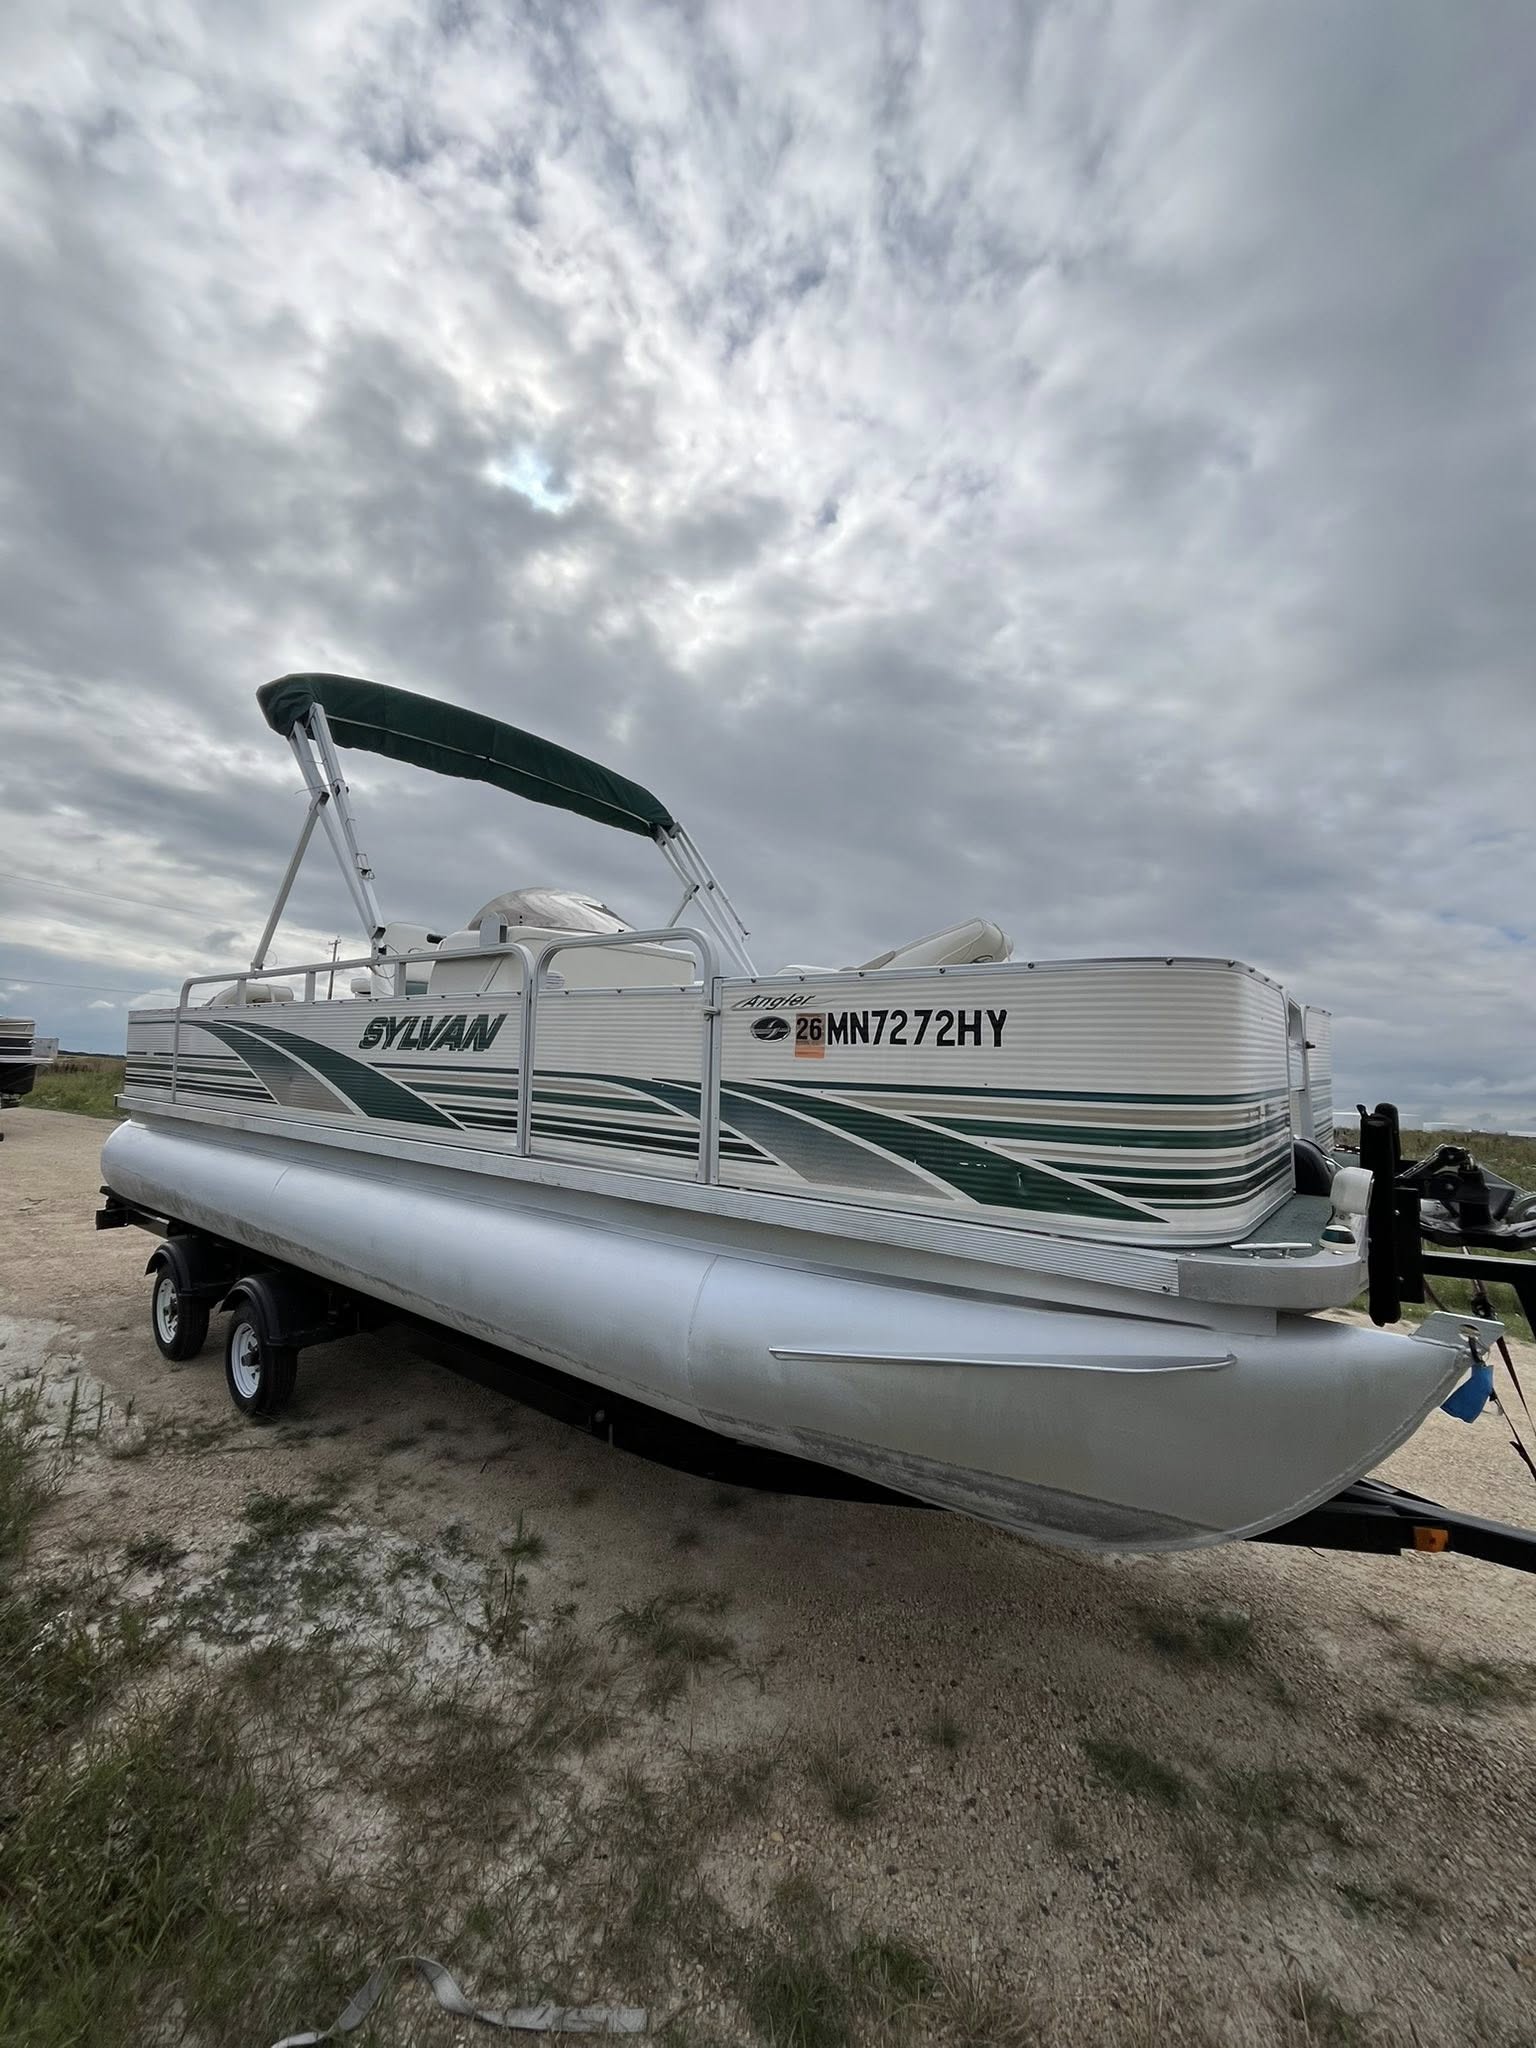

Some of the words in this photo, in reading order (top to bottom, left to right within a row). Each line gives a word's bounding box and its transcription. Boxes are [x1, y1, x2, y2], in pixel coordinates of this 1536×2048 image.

[742, 993, 816, 1010] Angler
[358, 1013, 508, 1052] SYLVAN
[796, 1017, 822, 1041] 26
[827, 1009, 1008, 1047] MN7272HY
